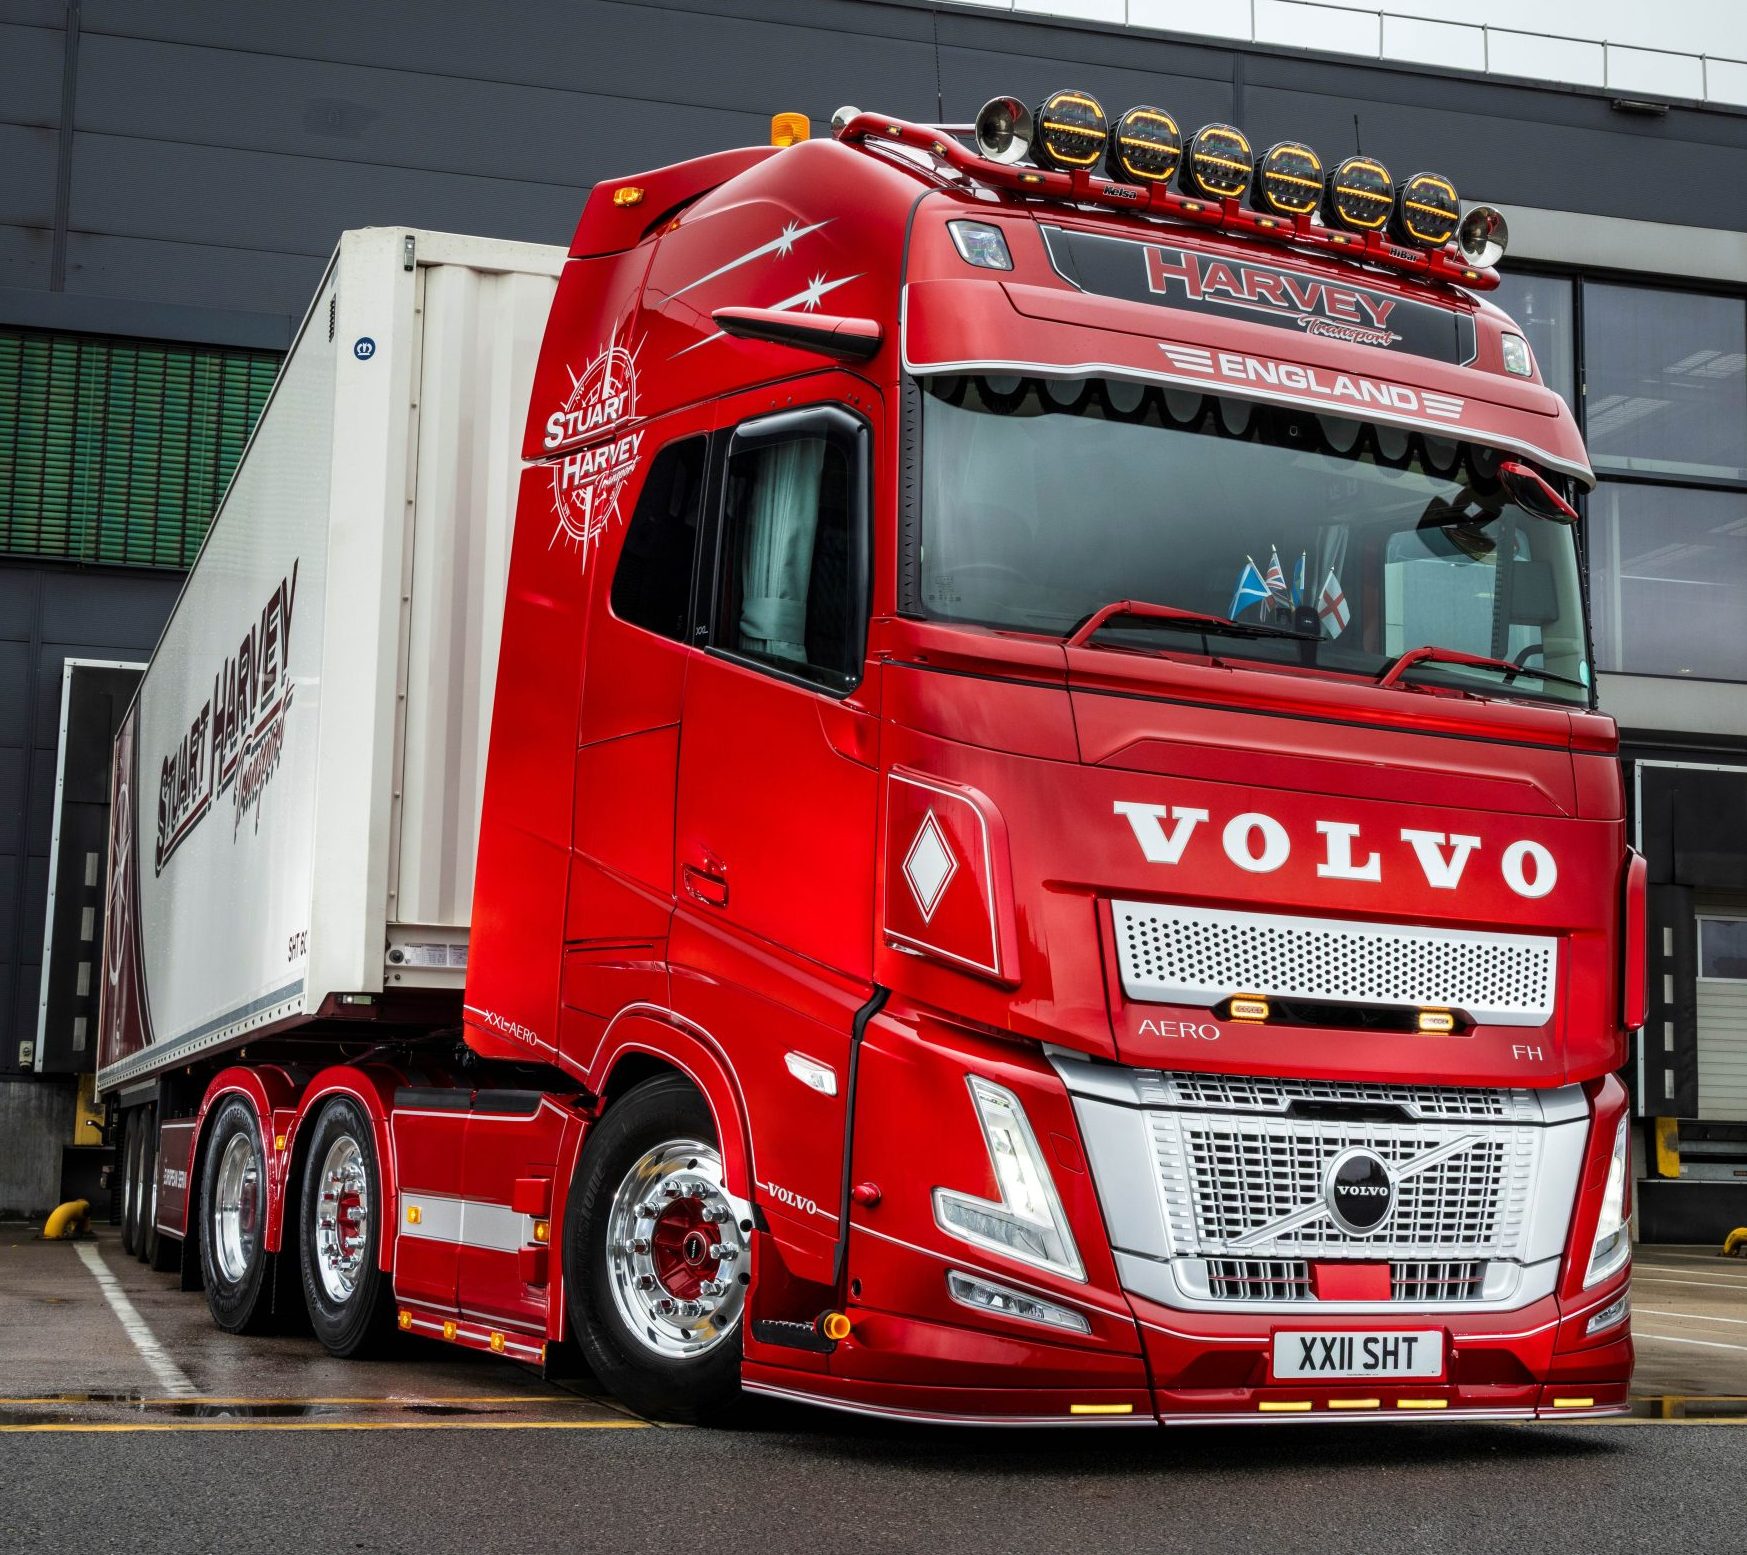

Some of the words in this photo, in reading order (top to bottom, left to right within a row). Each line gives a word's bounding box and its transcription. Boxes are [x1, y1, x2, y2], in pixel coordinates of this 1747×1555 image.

[1103, 185, 1137, 199] Kelsa
[1144, 246, 1396, 328] HARVEY
[1297, 313, 1402, 346] Transport
[1218, 353, 1418, 411] ENGLAND
[543, 391, 629, 449] STUART
[561, 429, 645, 491] HARVEY
[155, 698, 211, 878] STUART
[207, 556, 300, 801] HARVEY
[232, 676, 295, 845] Transport
[1113, 800, 1558, 898] VOLVO
[484, 1009, 537, 1046] XXL-AERO
[1138, 1019, 1221, 1041] AERO
[1512, 1044, 1543, 1061] FH
[767, 1181, 817, 1215] VOLVO
[1336, 1185, 1389, 1197] VOLVO
[1362, 1336, 1419, 1370] SHT
